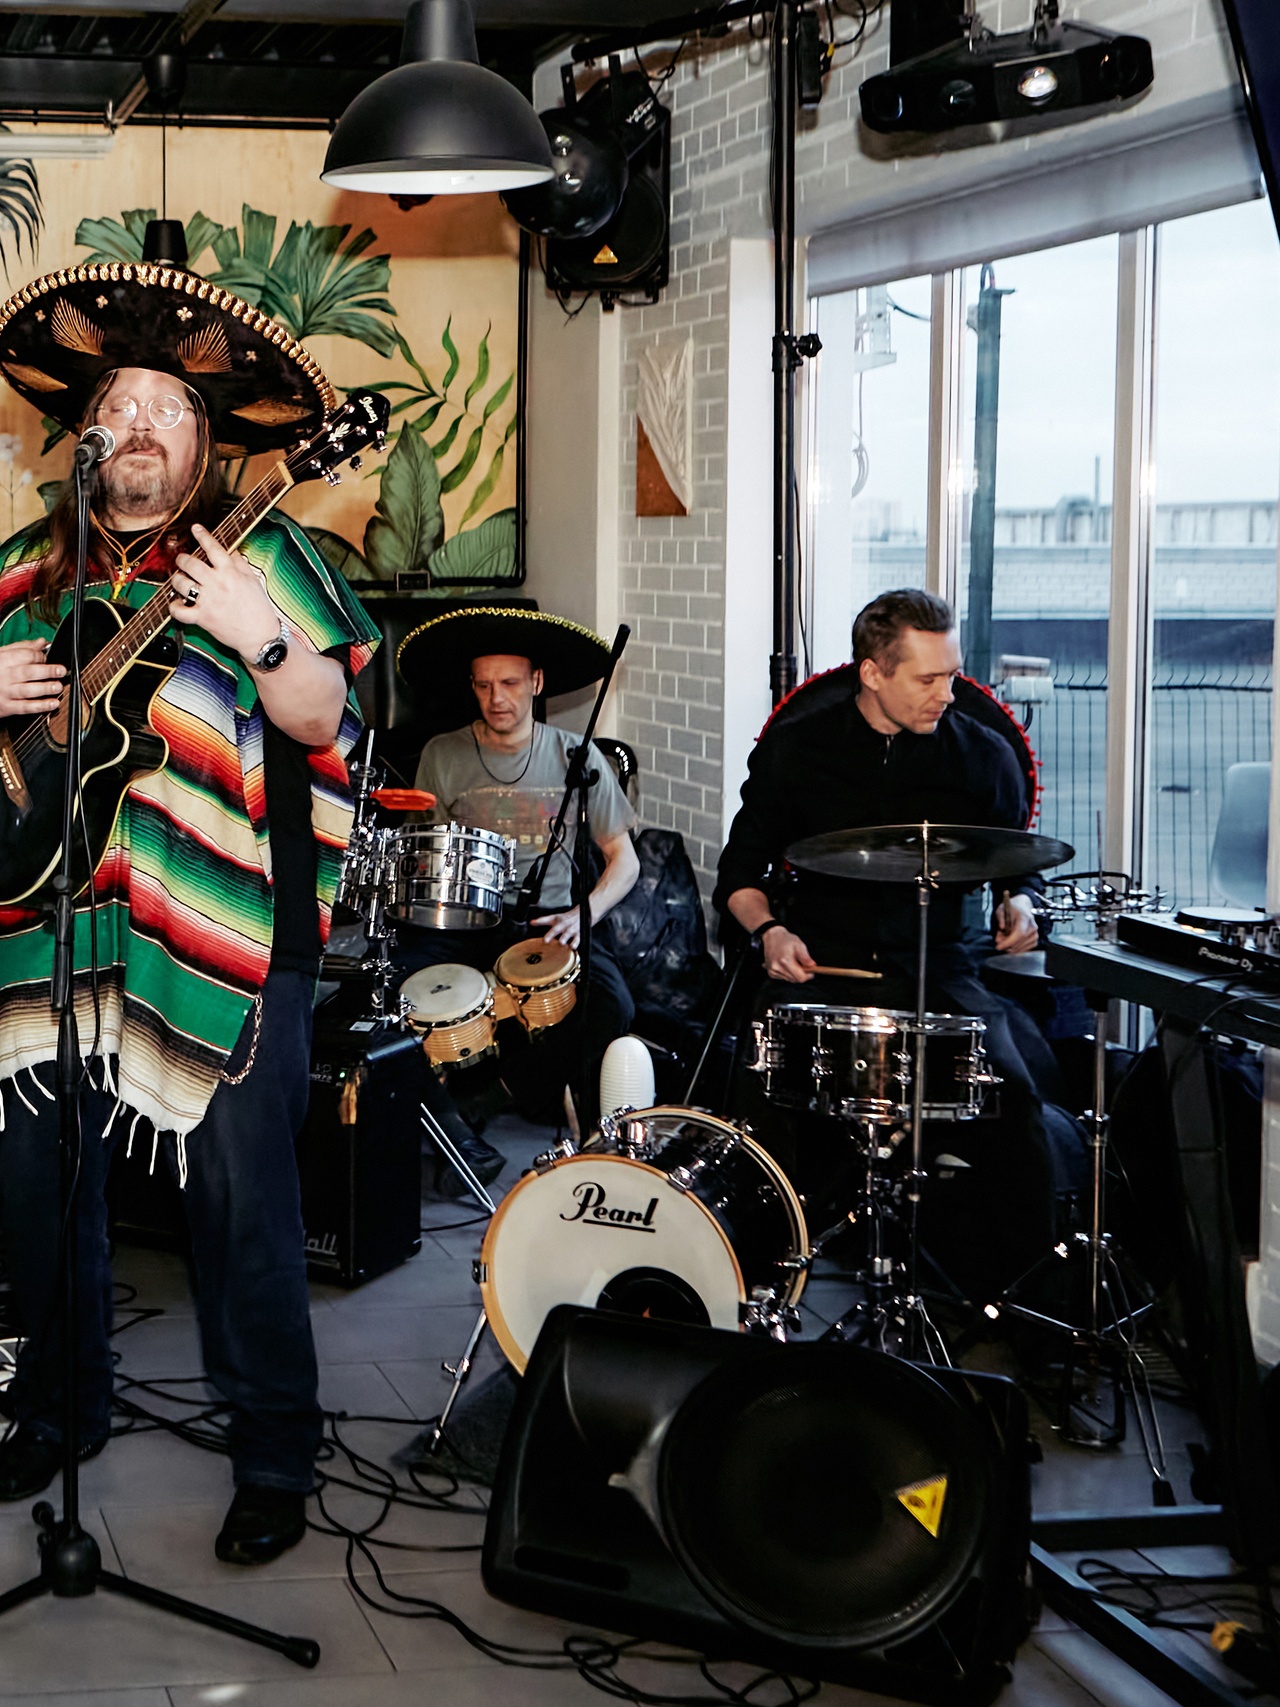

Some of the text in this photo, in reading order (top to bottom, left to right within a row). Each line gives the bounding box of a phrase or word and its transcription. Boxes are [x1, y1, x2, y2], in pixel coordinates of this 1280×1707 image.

[358, 396, 379, 424] Ibanez
[1198, 946, 1240, 966] Pioneer
[559, 1181, 659, 1228] Pearl
